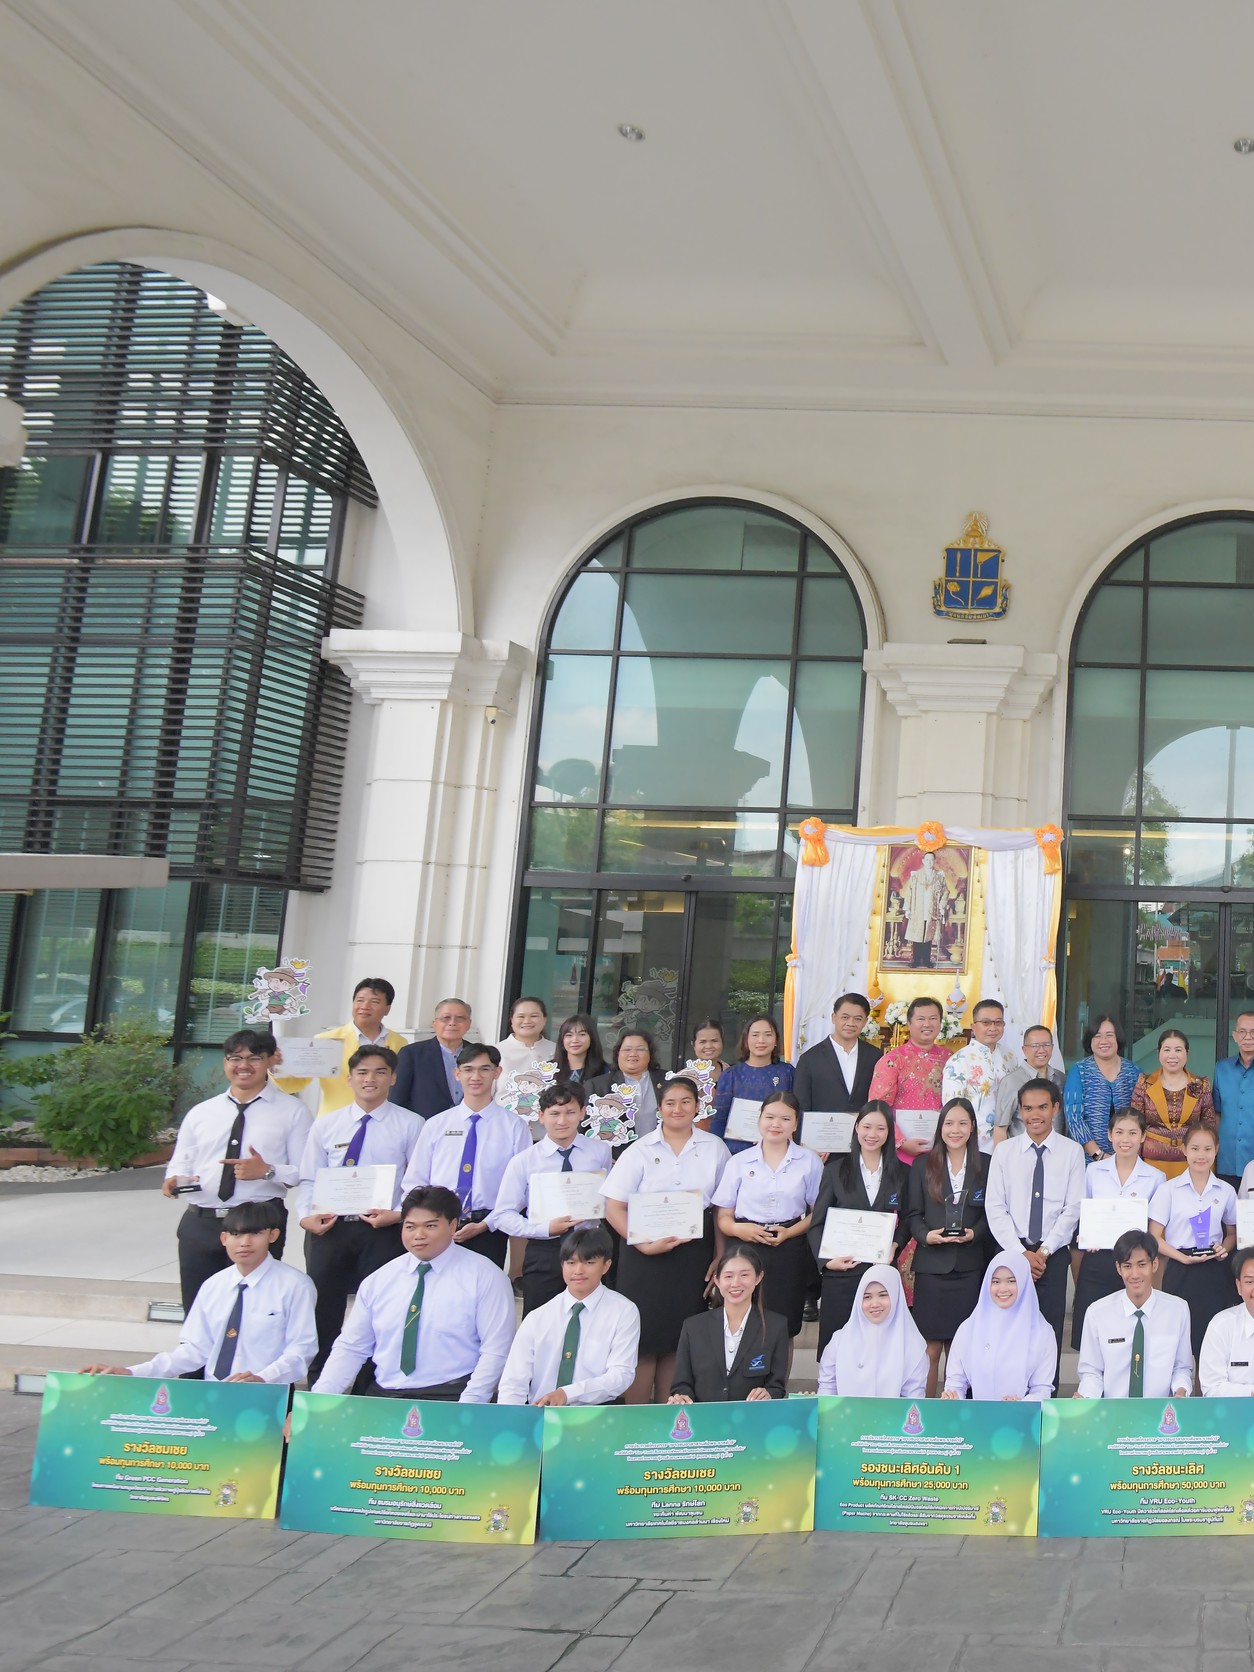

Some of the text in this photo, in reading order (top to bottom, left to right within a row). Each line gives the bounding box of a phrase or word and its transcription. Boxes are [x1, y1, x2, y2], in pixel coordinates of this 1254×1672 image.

[123, 1441, 188, 1455] รางวัลชมเชย
[98, 1456, 210, 1471] พร้อมทุนการศึกษา 10,000 บาท
[861, 1462, 961, 1476] รองชนะเลิศอันดับ 1
[1132, 1462, 1204, 1476] รางวัลชนะเลิศ
[374, 1464, 442, 1480] รางวัลชมเชย
[644, 1467, 716, 1481] รางวัลชมเชย
[350, 1479, 465, 1496] พร้อมทุนการศึกษา 10,000 บาท
[616, 1482, 741, 1498] พร้อมทุนการศึกษา 10,000 บาท
[852, 1477, 969, 1490] พร้อมทุนการศึกษา 25,000 บาท
[1110, 1480, 1226, 1493] พร้อมทุนการศึกษา 50,000 บาท
